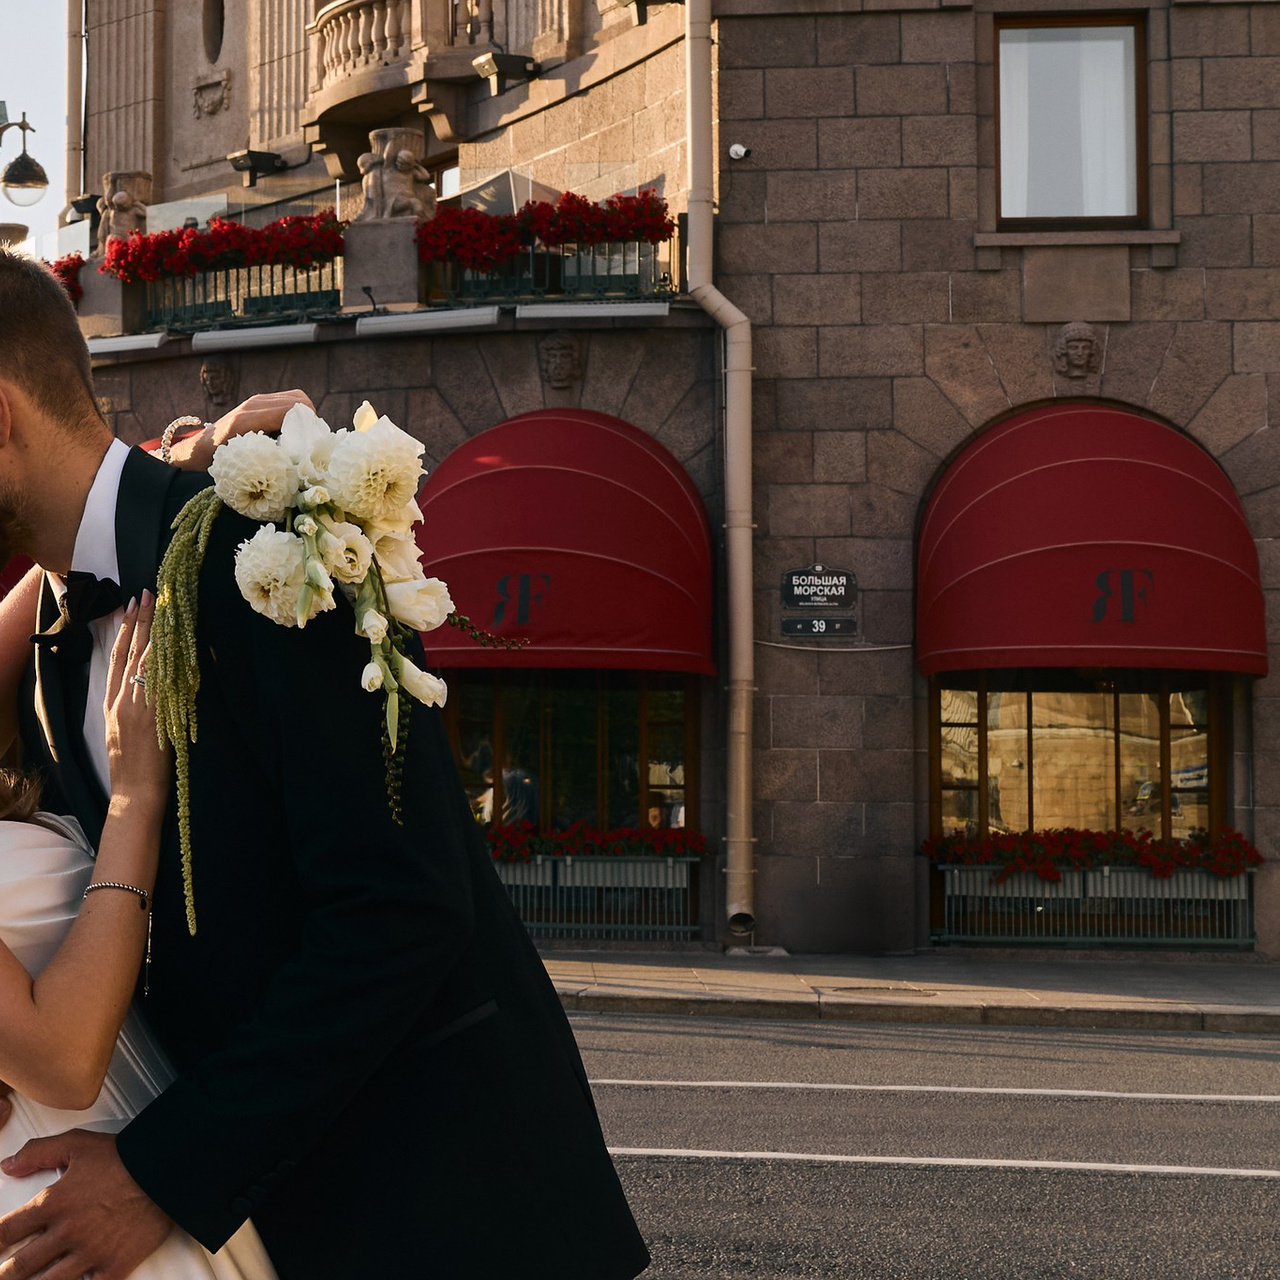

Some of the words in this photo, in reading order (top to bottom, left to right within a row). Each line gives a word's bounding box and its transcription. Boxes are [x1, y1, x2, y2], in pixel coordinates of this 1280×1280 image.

[792, 575, 847, 586] БОЛЬШАЯ
[793, 586, 845, 596] МОРСКАЯ
[812, 620, 826, 632] 39
